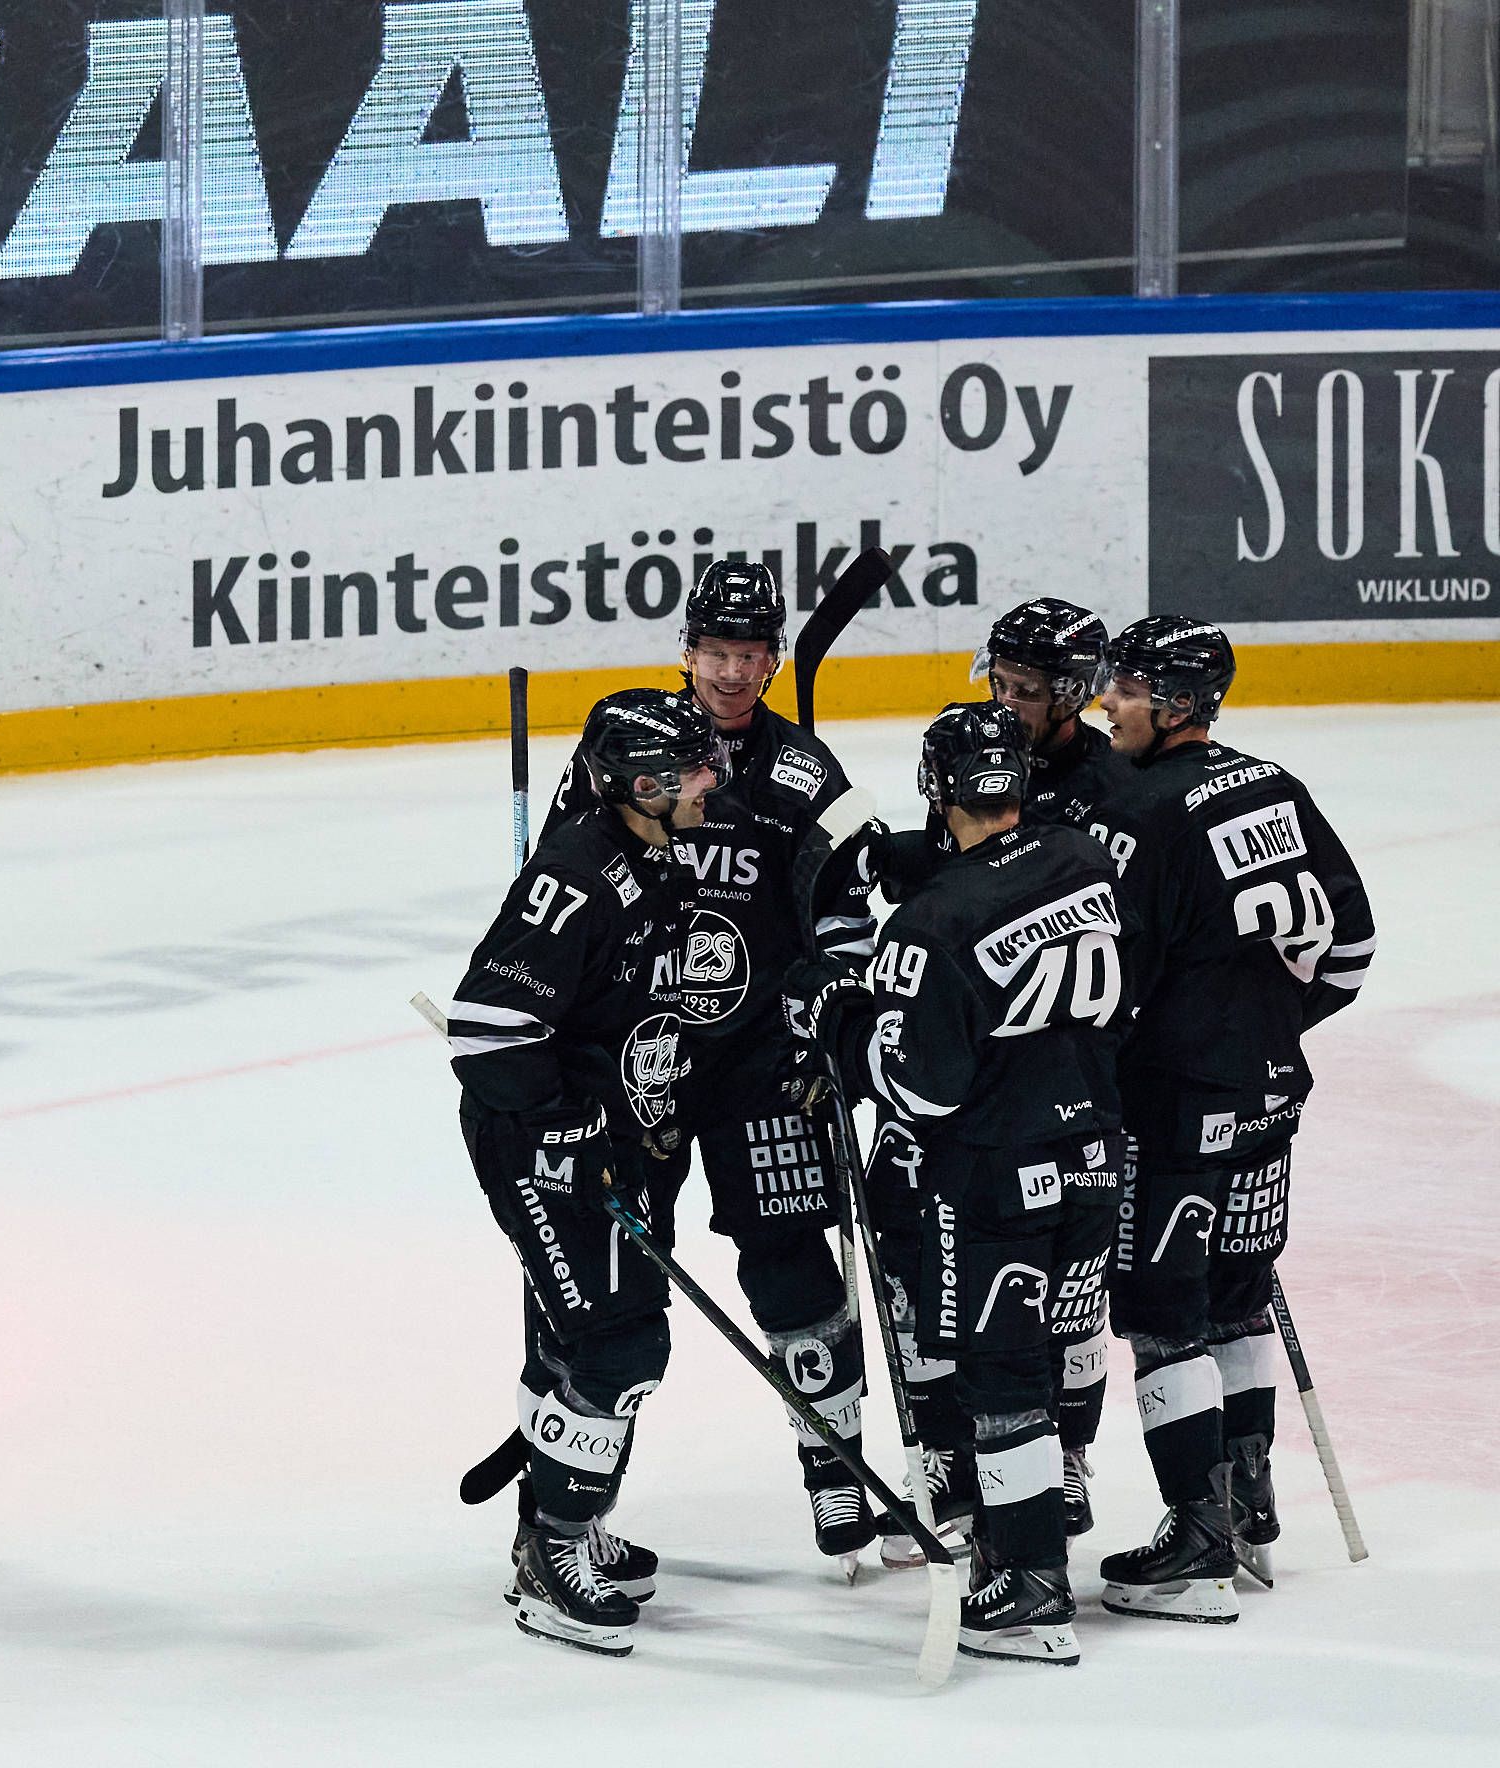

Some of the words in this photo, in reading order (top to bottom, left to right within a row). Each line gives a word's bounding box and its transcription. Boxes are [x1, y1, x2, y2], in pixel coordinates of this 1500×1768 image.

[102, 365, 907, 498] Juhankiinteistö
[940, 363, 1073, 476] Oy
[193, 520, 978, 648] Kiinteistökka
[1358, 579, 1491, 603] WIKLUND
[605, 706, 680, 737] SKECHERS
[628, 748, 663, 758] BAUER
[990, 753, 1002, 765] 49
[1184, 762, 1281, 812] SKECHER
[700, 821, 736, 831] AUER
[1000, 831, 1019, 846] FELIX
[1000, 839, 1041, 866] BAUER
[521, 873, 589, 935] 97
[683, 931, 735, 982] PS
[875, 940, 928, 998] 49
[989, 931, 1122, 1038] 49
[685, 994, 720, 1014] 1922
[1206, 1123, 1233, 1144] JP
[533, 1178, 573, 1194] MASKU
[1027, 1174, 1056, 1197] JP
[758, 1192, 828, 1217] LOIKKA
[1219, 1228, 1282, 1254] LOIKKA
[984, 1600, 1016, 1621] BAUER
